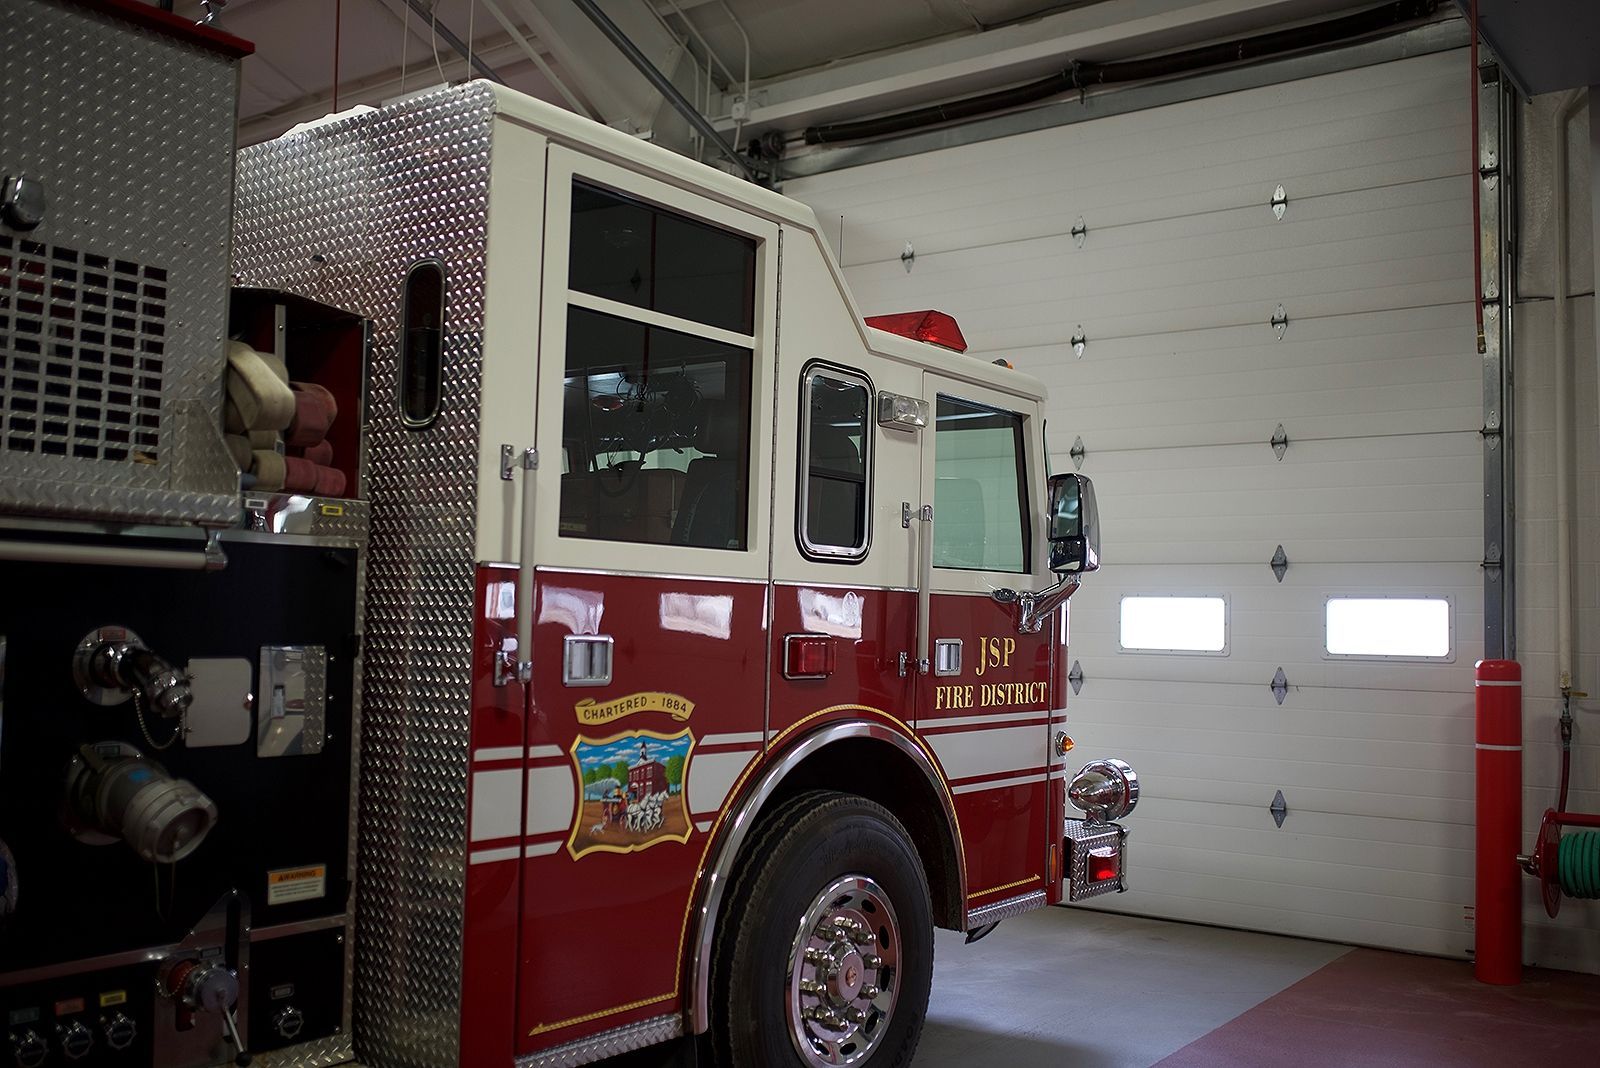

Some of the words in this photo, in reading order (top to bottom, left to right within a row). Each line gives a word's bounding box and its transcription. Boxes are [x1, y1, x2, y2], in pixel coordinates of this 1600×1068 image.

[975, 636, 1016, 676] JSP
[583, 696, 647, 720] CHARTERED
[661, 697, 687, 713] 1884
[935, 684, 974, 710] FIRE
[980, 681, 1047, 707] DISTRICT
